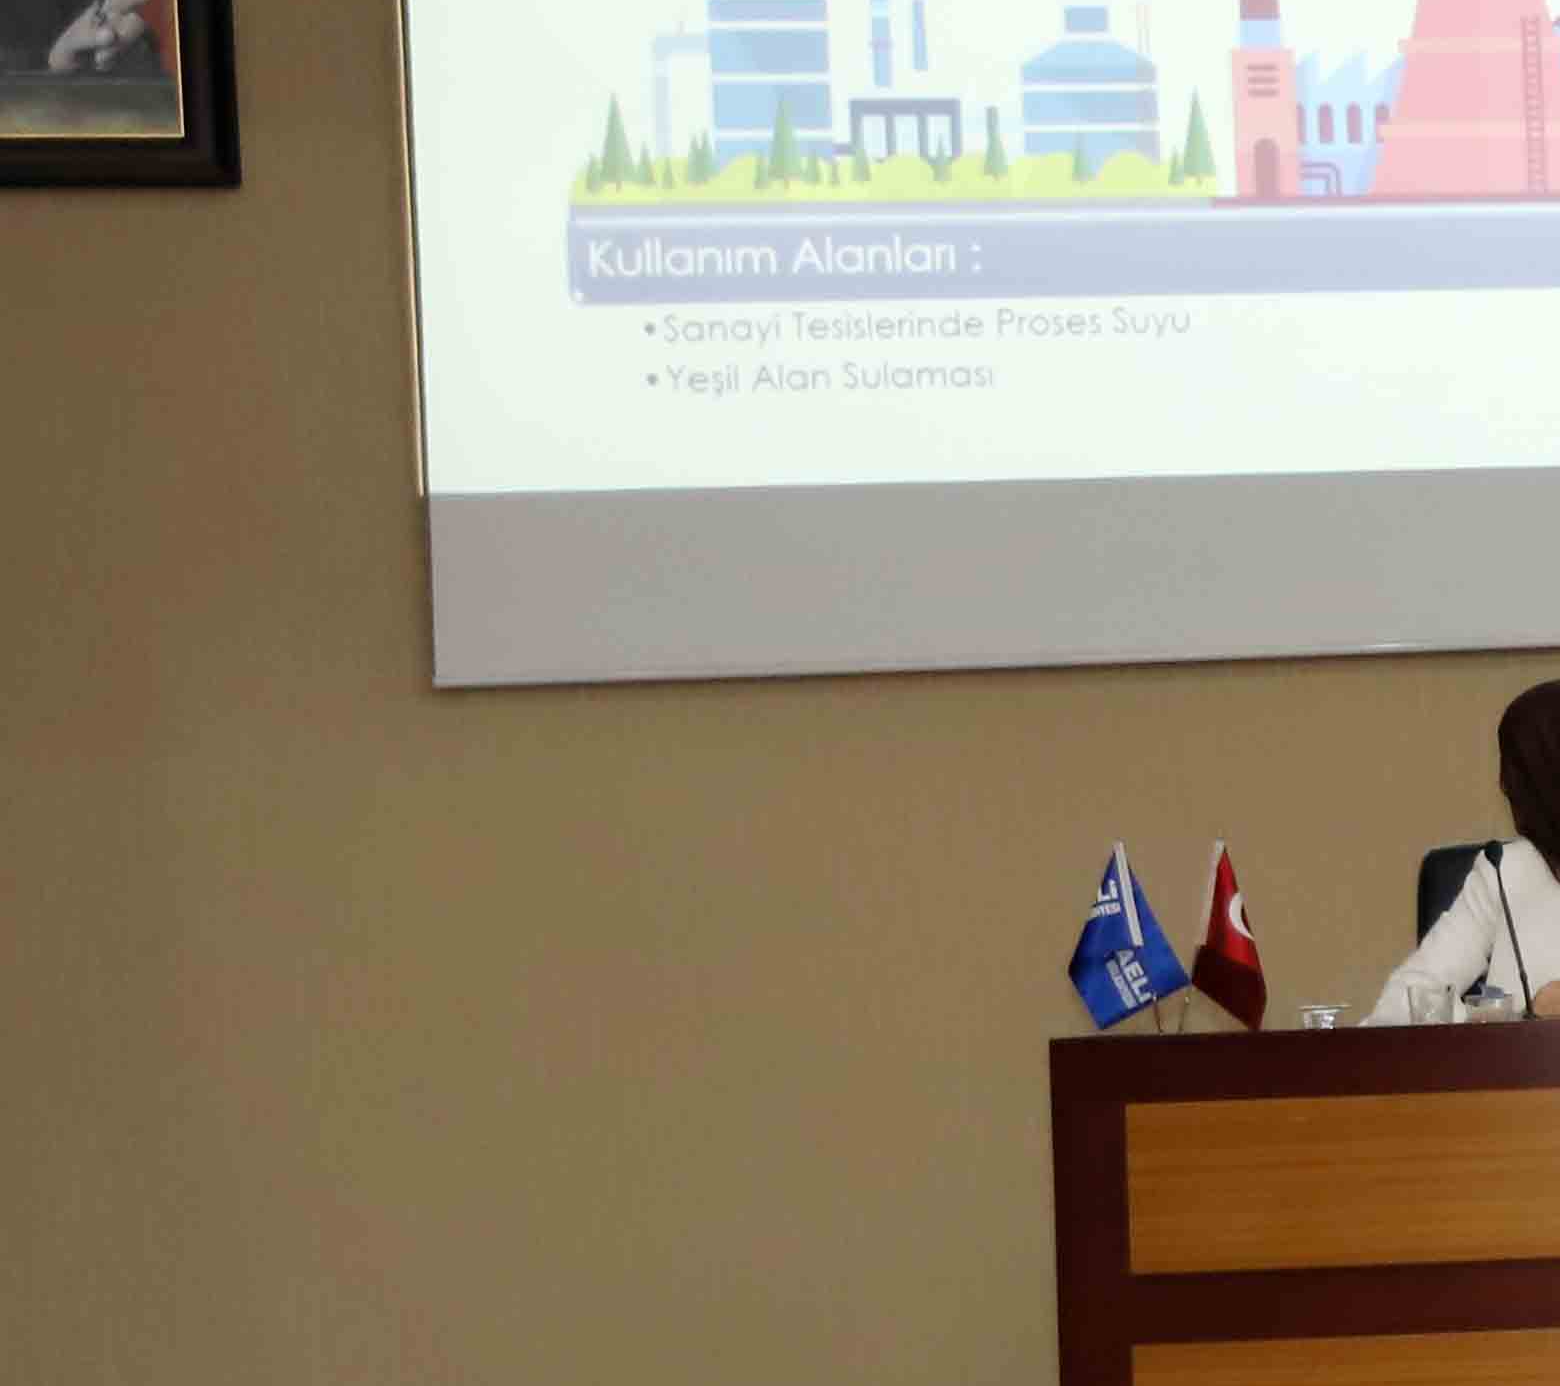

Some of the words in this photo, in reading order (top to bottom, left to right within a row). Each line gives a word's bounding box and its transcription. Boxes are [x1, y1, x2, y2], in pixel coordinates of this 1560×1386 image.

[587, 238, 777, 279] Kullanım
[792, 234, 957, 275] Alanları
[663, 311, 781, 349] Sanayi
[792, 310, 984, 343] Tesislerinde
[996, 308, 1101, 340] Proses
[1111, 307, 1191, 338] Suyu
[666, 363, 740, 400] Yeşil
[751, 362, 832, 393] Alan
[842, 360, 995, 392] Sulaması
